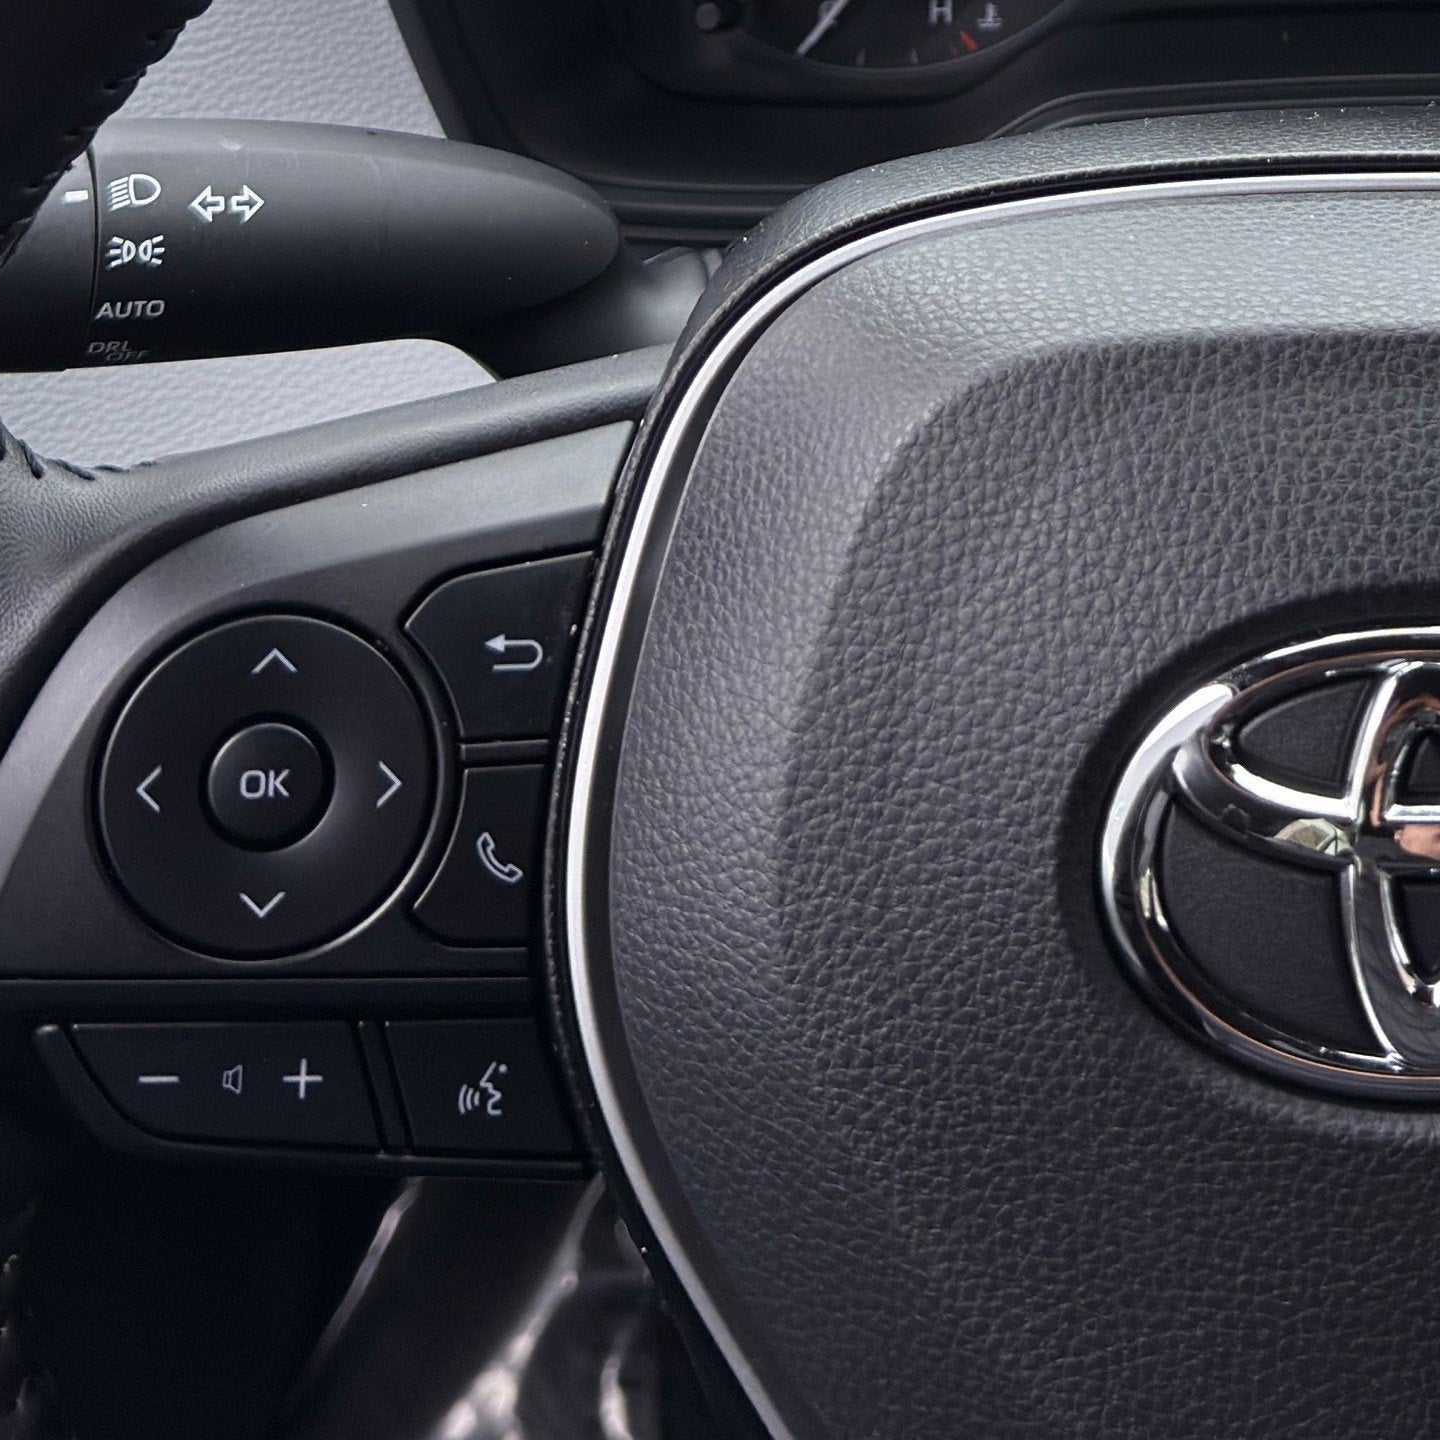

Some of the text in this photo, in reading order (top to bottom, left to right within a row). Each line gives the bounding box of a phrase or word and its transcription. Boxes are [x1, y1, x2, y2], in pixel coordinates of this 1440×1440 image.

[95, 300, 165, 320] AUTO
[87, 341, 132, 354] DRL
[239, 769, 289, 798] OK
